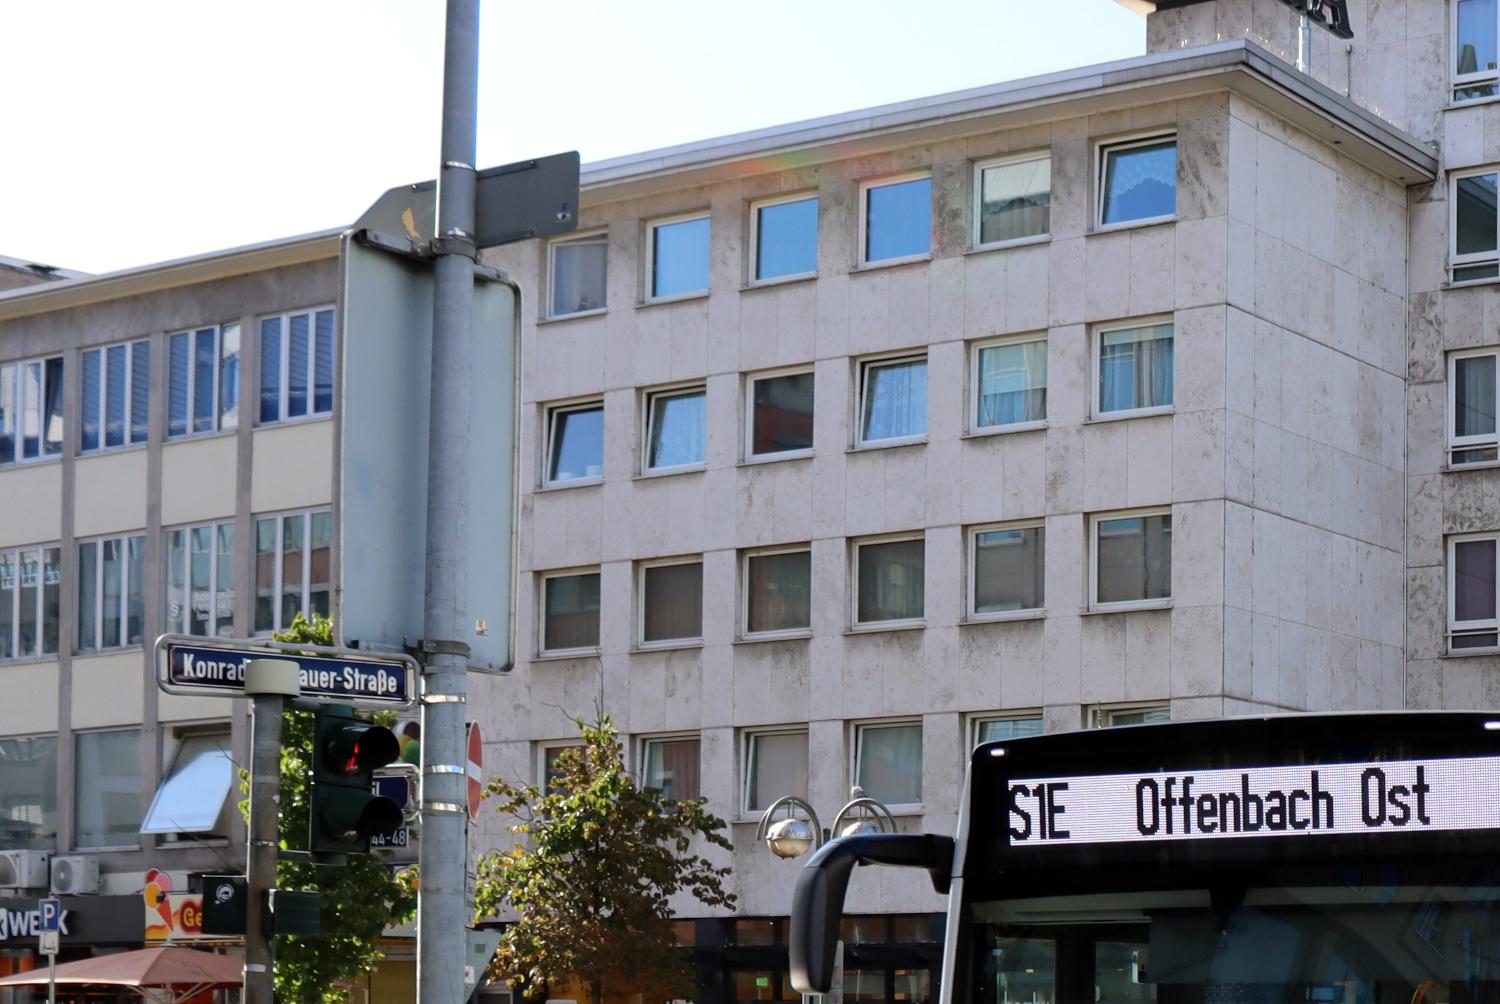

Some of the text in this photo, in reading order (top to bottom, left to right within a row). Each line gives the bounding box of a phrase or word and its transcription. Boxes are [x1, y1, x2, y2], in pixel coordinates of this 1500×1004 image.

[182, 652, 398, 695] Konradauer-Straße
[1008, 765, 1431, 840] S1E Offenbach Ost
[9, 910, 69, 936] WEK
[43, 904, 55, 928] P
